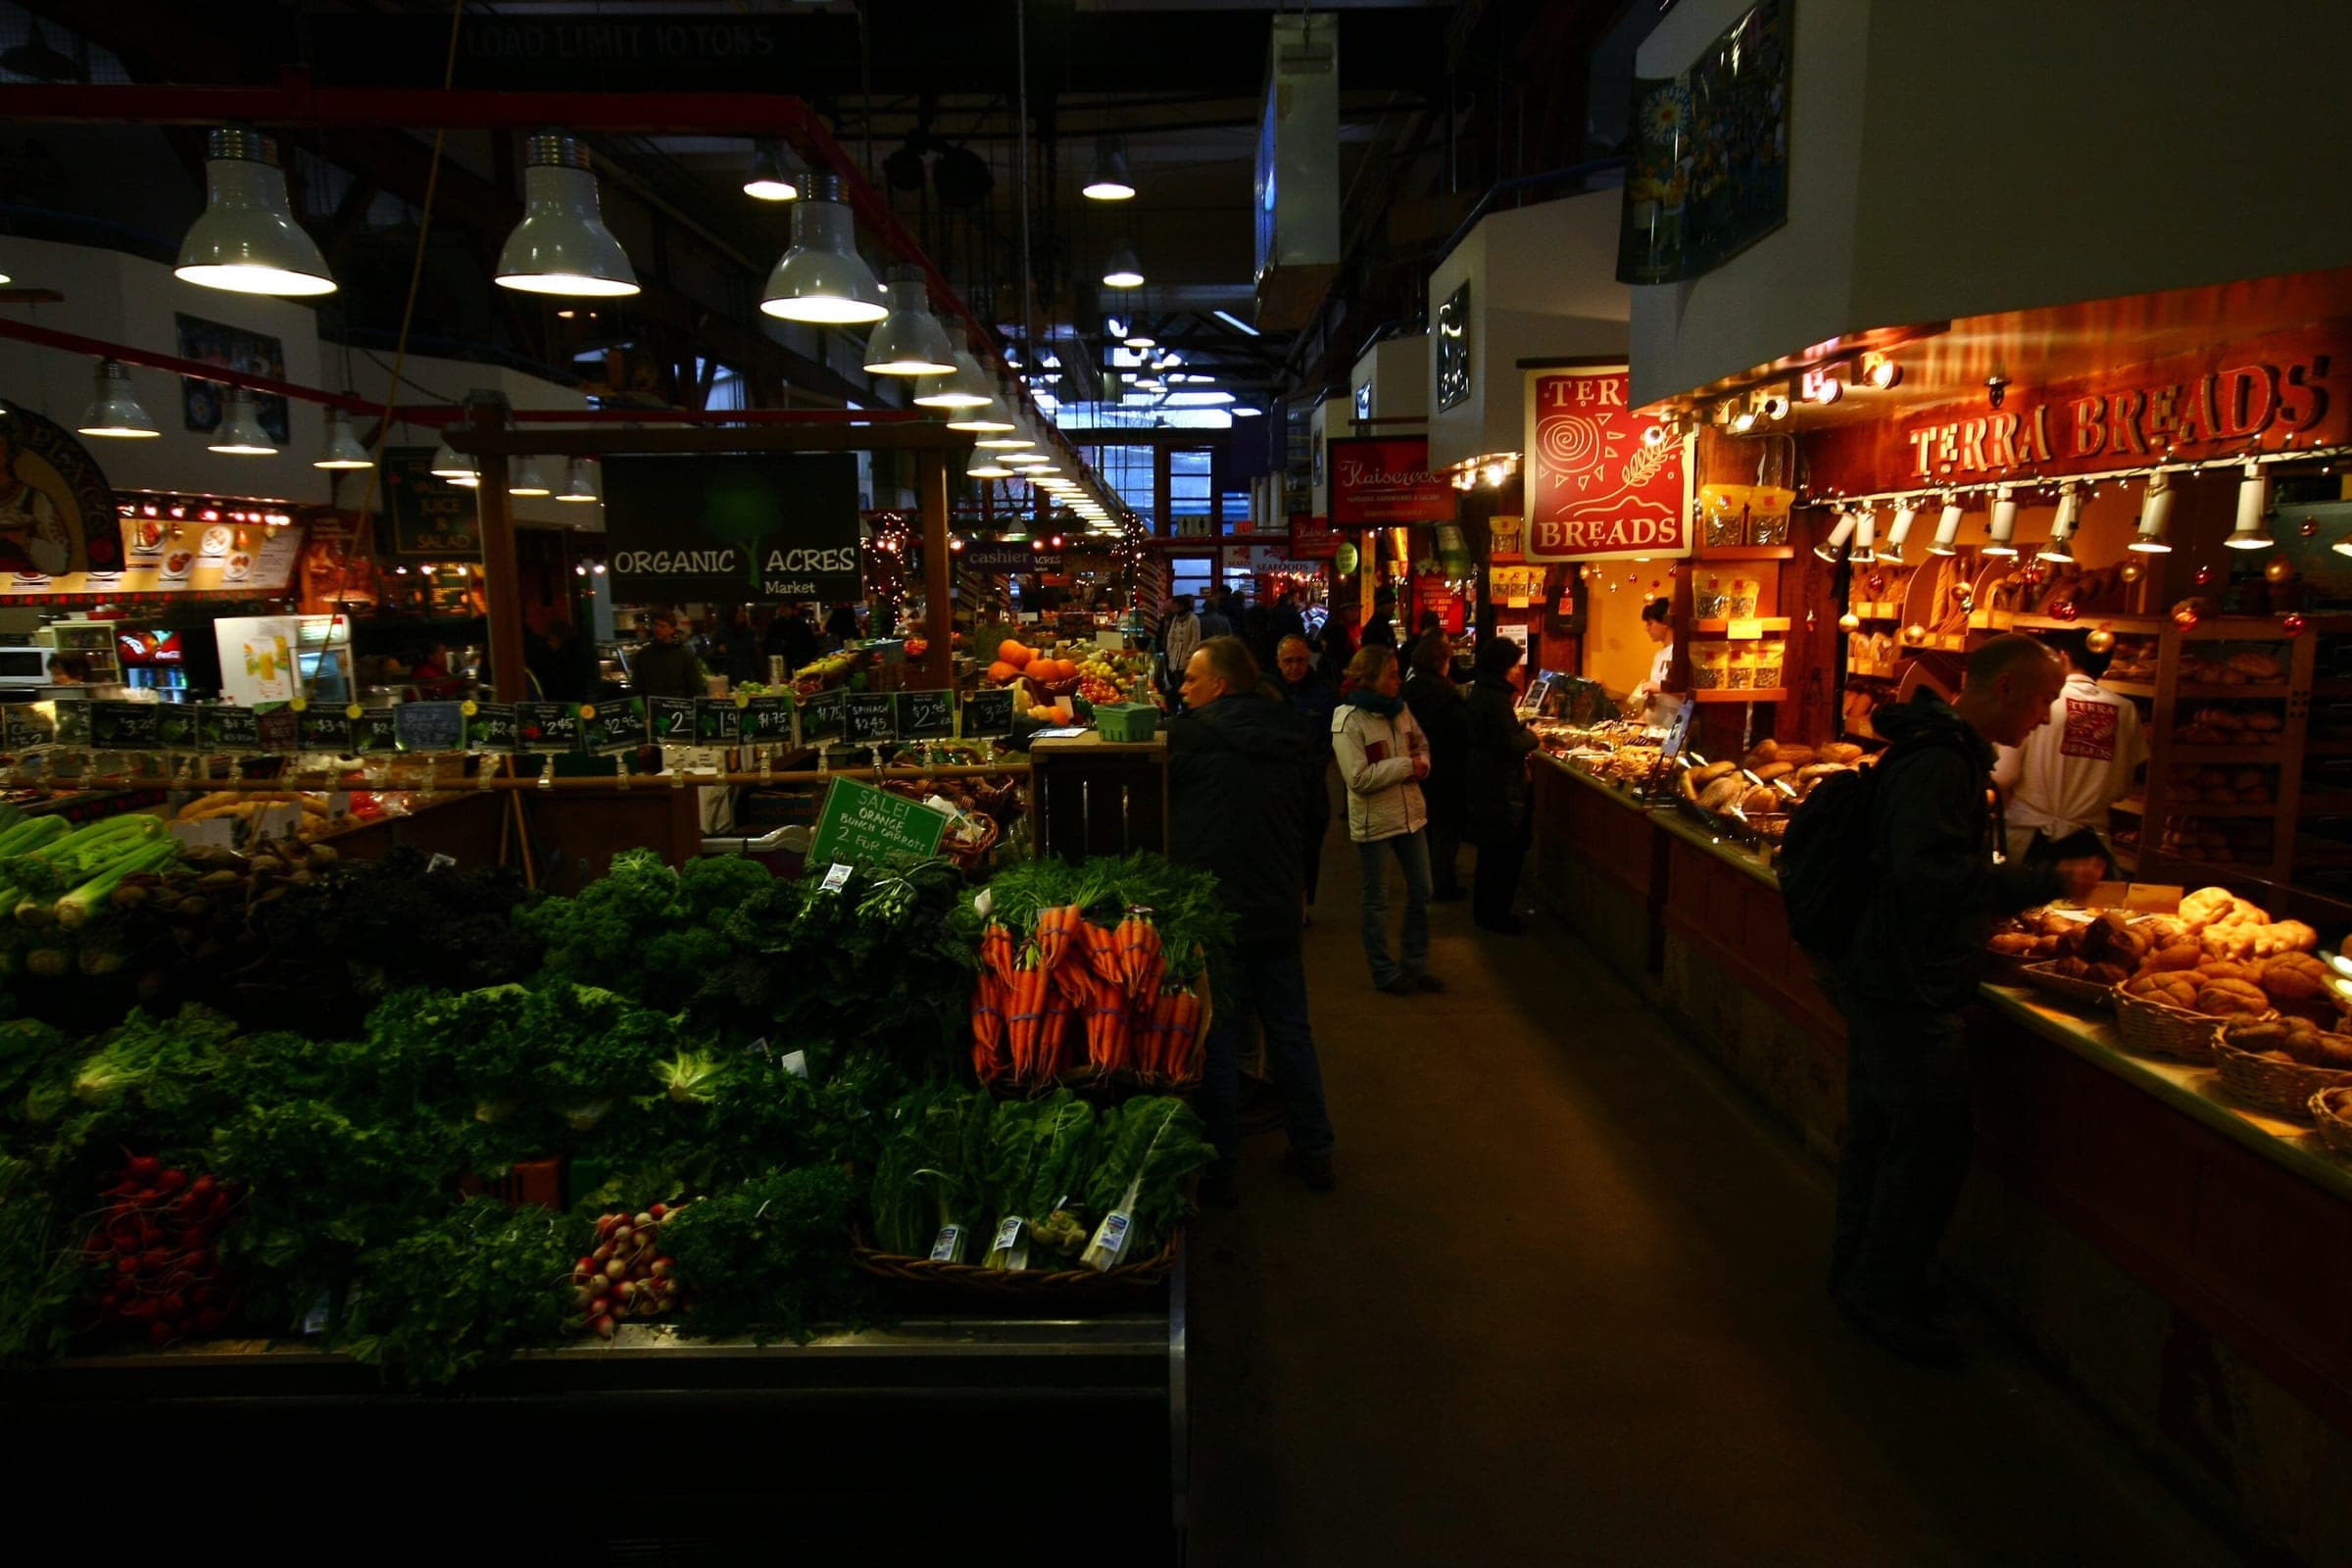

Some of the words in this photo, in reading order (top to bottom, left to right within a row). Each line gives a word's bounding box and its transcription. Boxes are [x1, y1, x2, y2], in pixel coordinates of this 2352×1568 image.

[466, 24, 545, 57] LOAD
[556, 23, 643, 59] LIMIT
[688, 23, 775, 56] TONS
[1909, 404, 2052, 478] TERRA
[2069, 355, 2331, 460] BREADS
[416, 534, 470, 550] SALAD
[1538, 517, 1678, 548] BREADS
[613, 550, 736, 573] ORGANIC
[764, 546, 856, 573] ACRES
[969, 548, 1029, 564] cashier
[1256, 564, 1309, 573] SEAFOODS
[764, 579, 816, 596] Market
[857, 791, 911, 820] SALE!
[840, 812, 876, 833] BUNCH
[880, 827, 927, 853] CARROTS
[858, 808, 906, 834] ORANGE
[836, 826, 850, 843] 2
[855, 835, 881, 852] FOR
